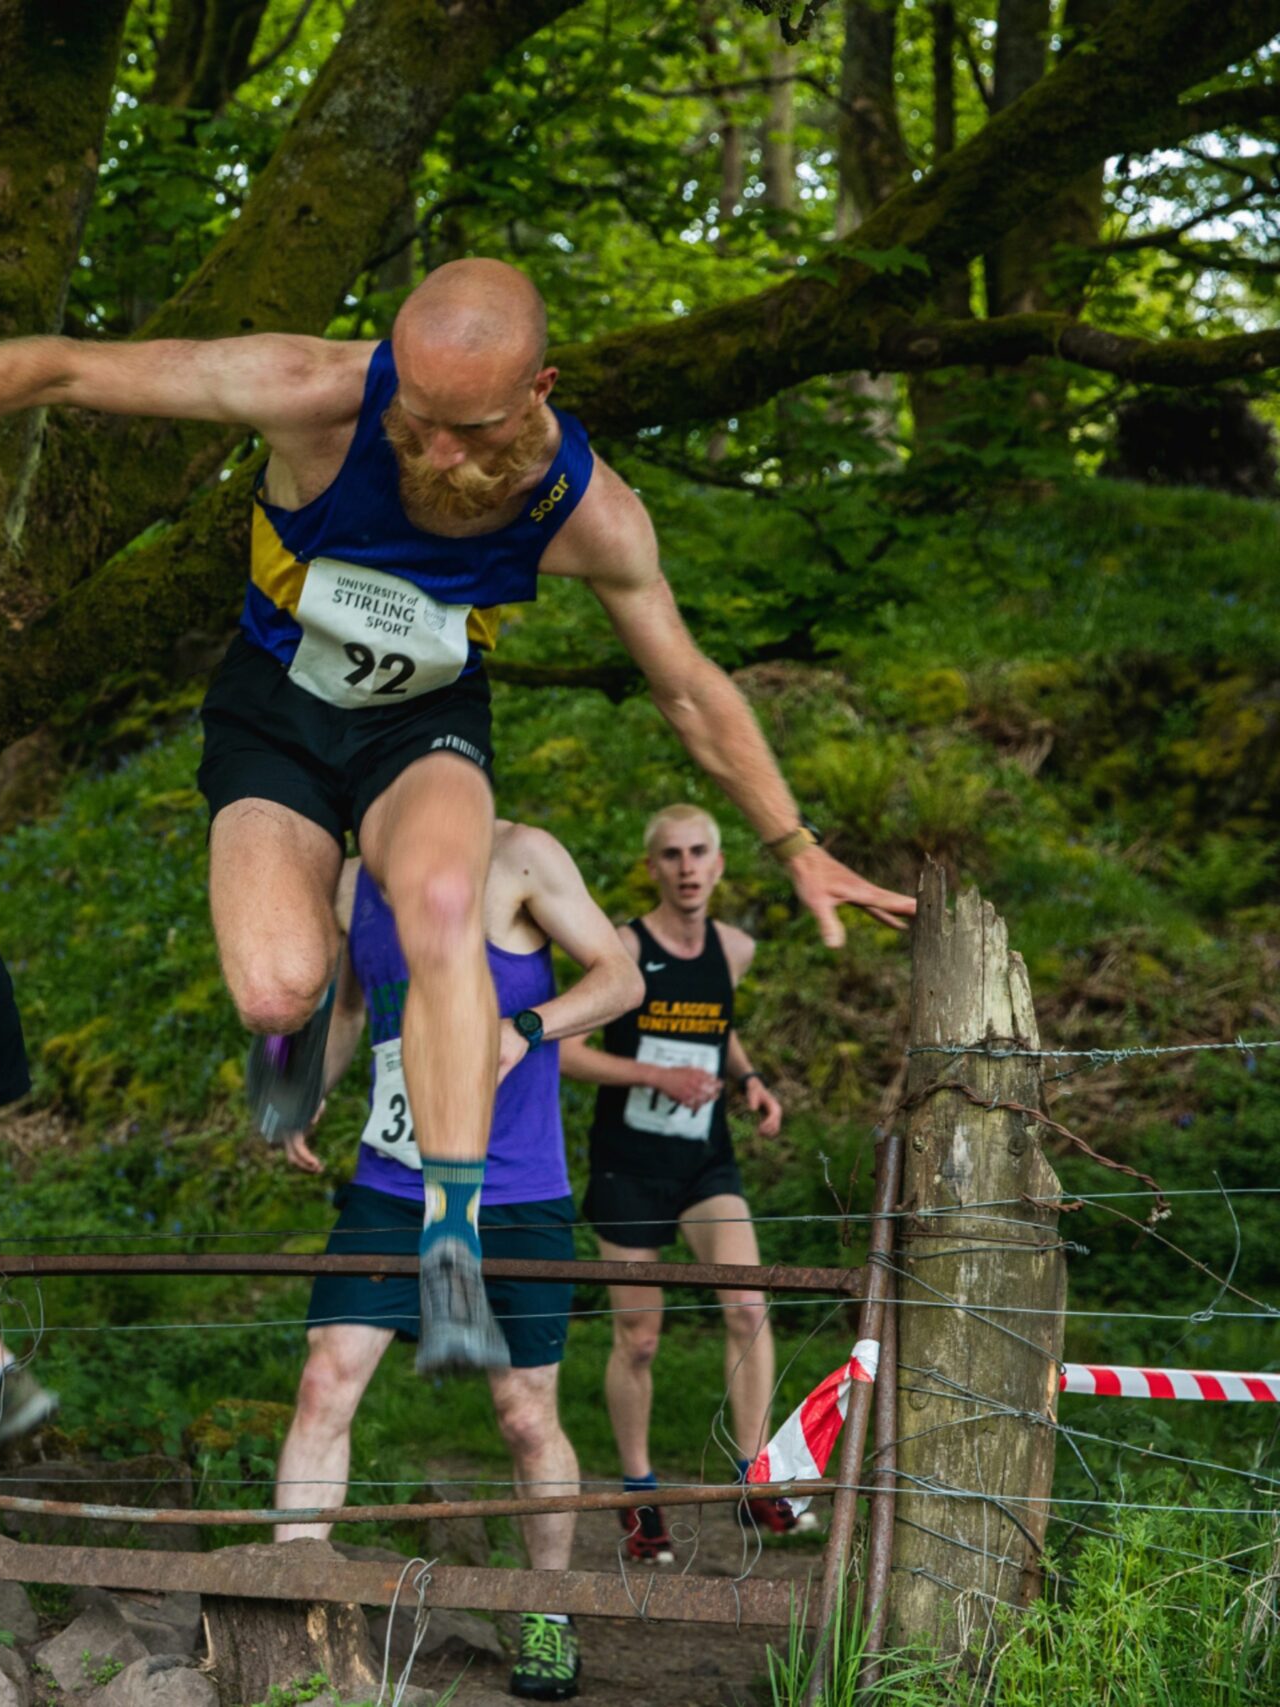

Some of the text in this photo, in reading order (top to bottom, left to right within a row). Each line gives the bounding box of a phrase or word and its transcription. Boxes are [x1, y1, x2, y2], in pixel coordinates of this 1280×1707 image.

[529, 473, 570, 522] soar
[332, 588, 417, 623] STIRLING
[336, 576, 420, 607] UNIVERSITY of
[365, 615, 412, 637] SPORT
[342, 642, 416, 695] 92
[381, 1093, 416, 1143] 3
